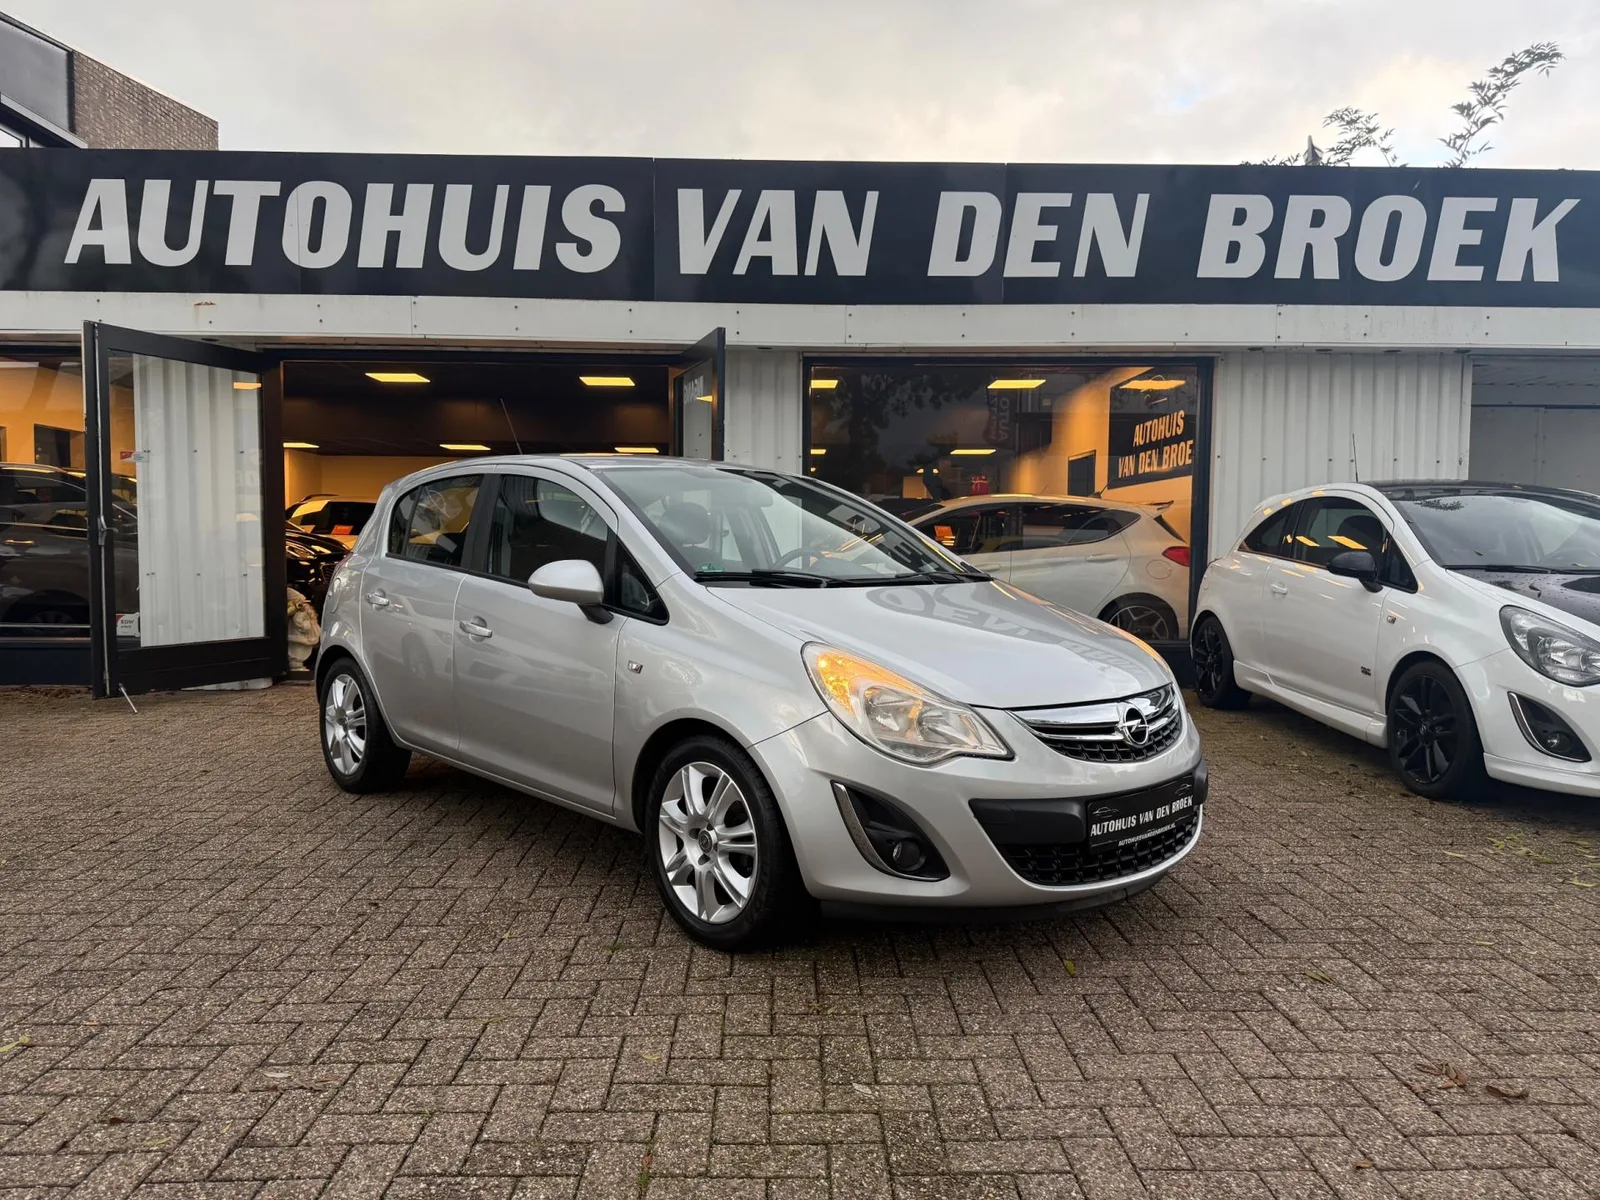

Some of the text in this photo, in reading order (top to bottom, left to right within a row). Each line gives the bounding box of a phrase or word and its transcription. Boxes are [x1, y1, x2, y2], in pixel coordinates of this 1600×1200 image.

[64, 178, 1581, 284] AUTOHUIS VAN DEN BROEK
[1133, 409, 1185, 447] AUTOHUIS
[1118, 440, 1194, 478] VAN DEN BROE
[1090, 795, 1193, 836] AUTOHUIS VAN DEN BROEK
